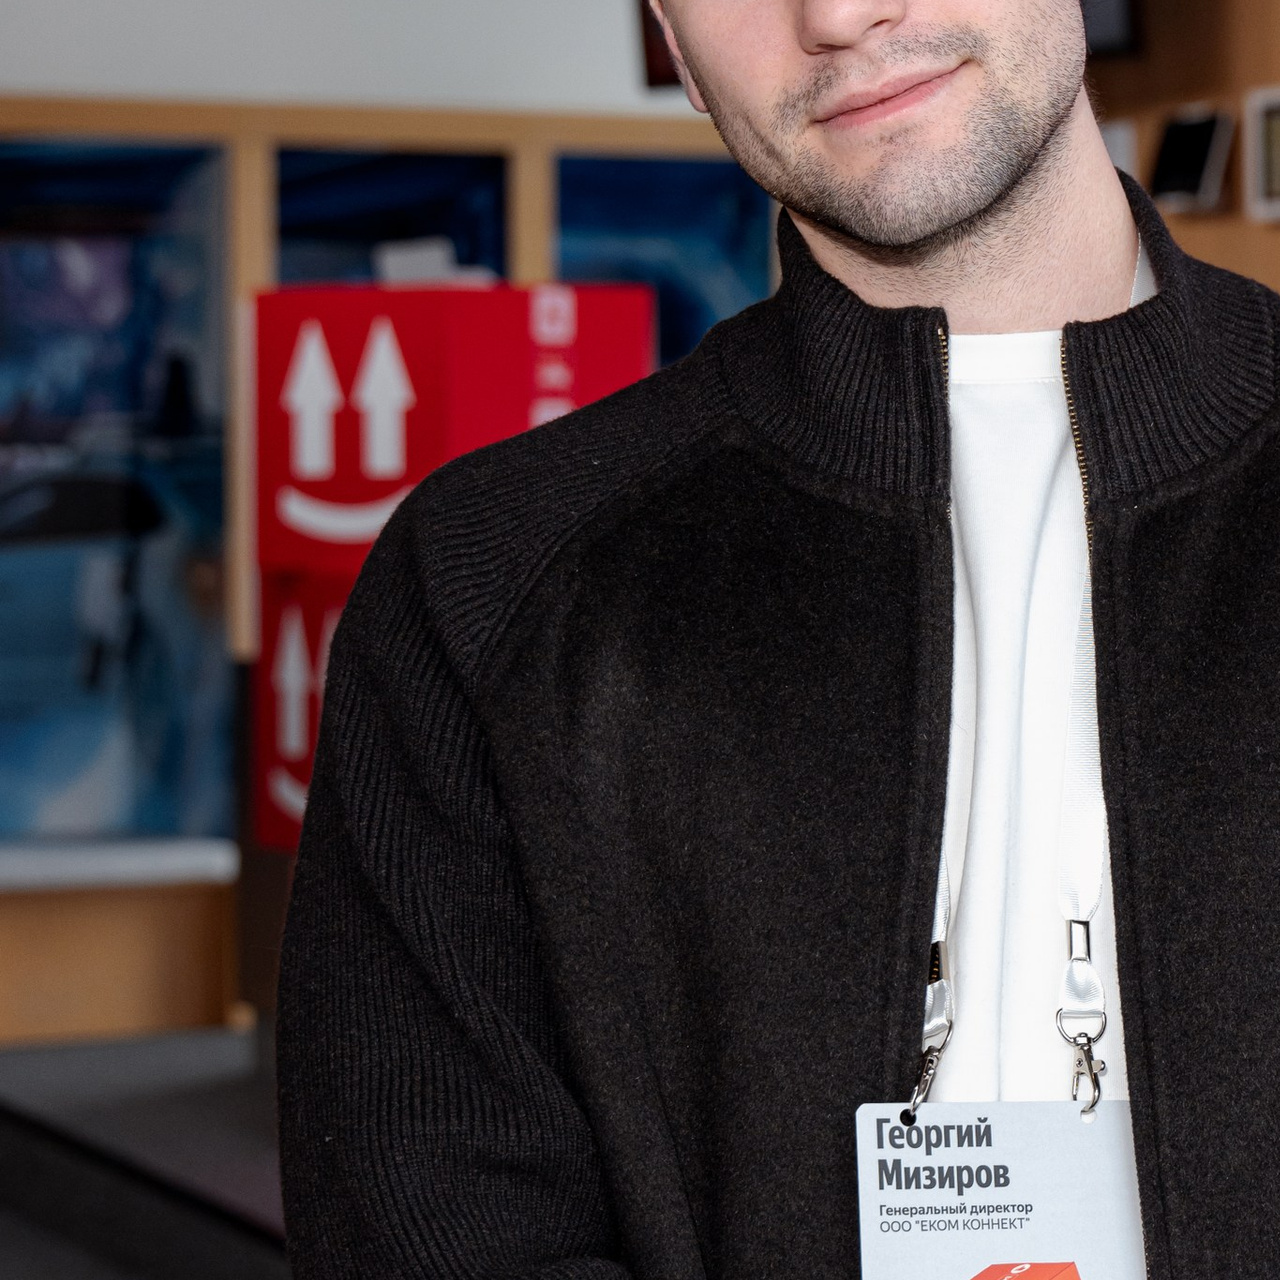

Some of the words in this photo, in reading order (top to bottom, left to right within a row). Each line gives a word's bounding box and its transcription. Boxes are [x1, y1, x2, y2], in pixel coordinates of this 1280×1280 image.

[876, 1117, 993, 1156] Георгий
[878, 1159, 1011, 1196] Мизиров
[879, 1203, 967, 1218] Генеральный
[970, 1202, 1033, 1216] директор
[880, 1220, 912, 1233] ООО
[915, 1219, 959, 1232] "ЕКОМ
[963, 1217, 1030, 1231] КОННЕКТ"
